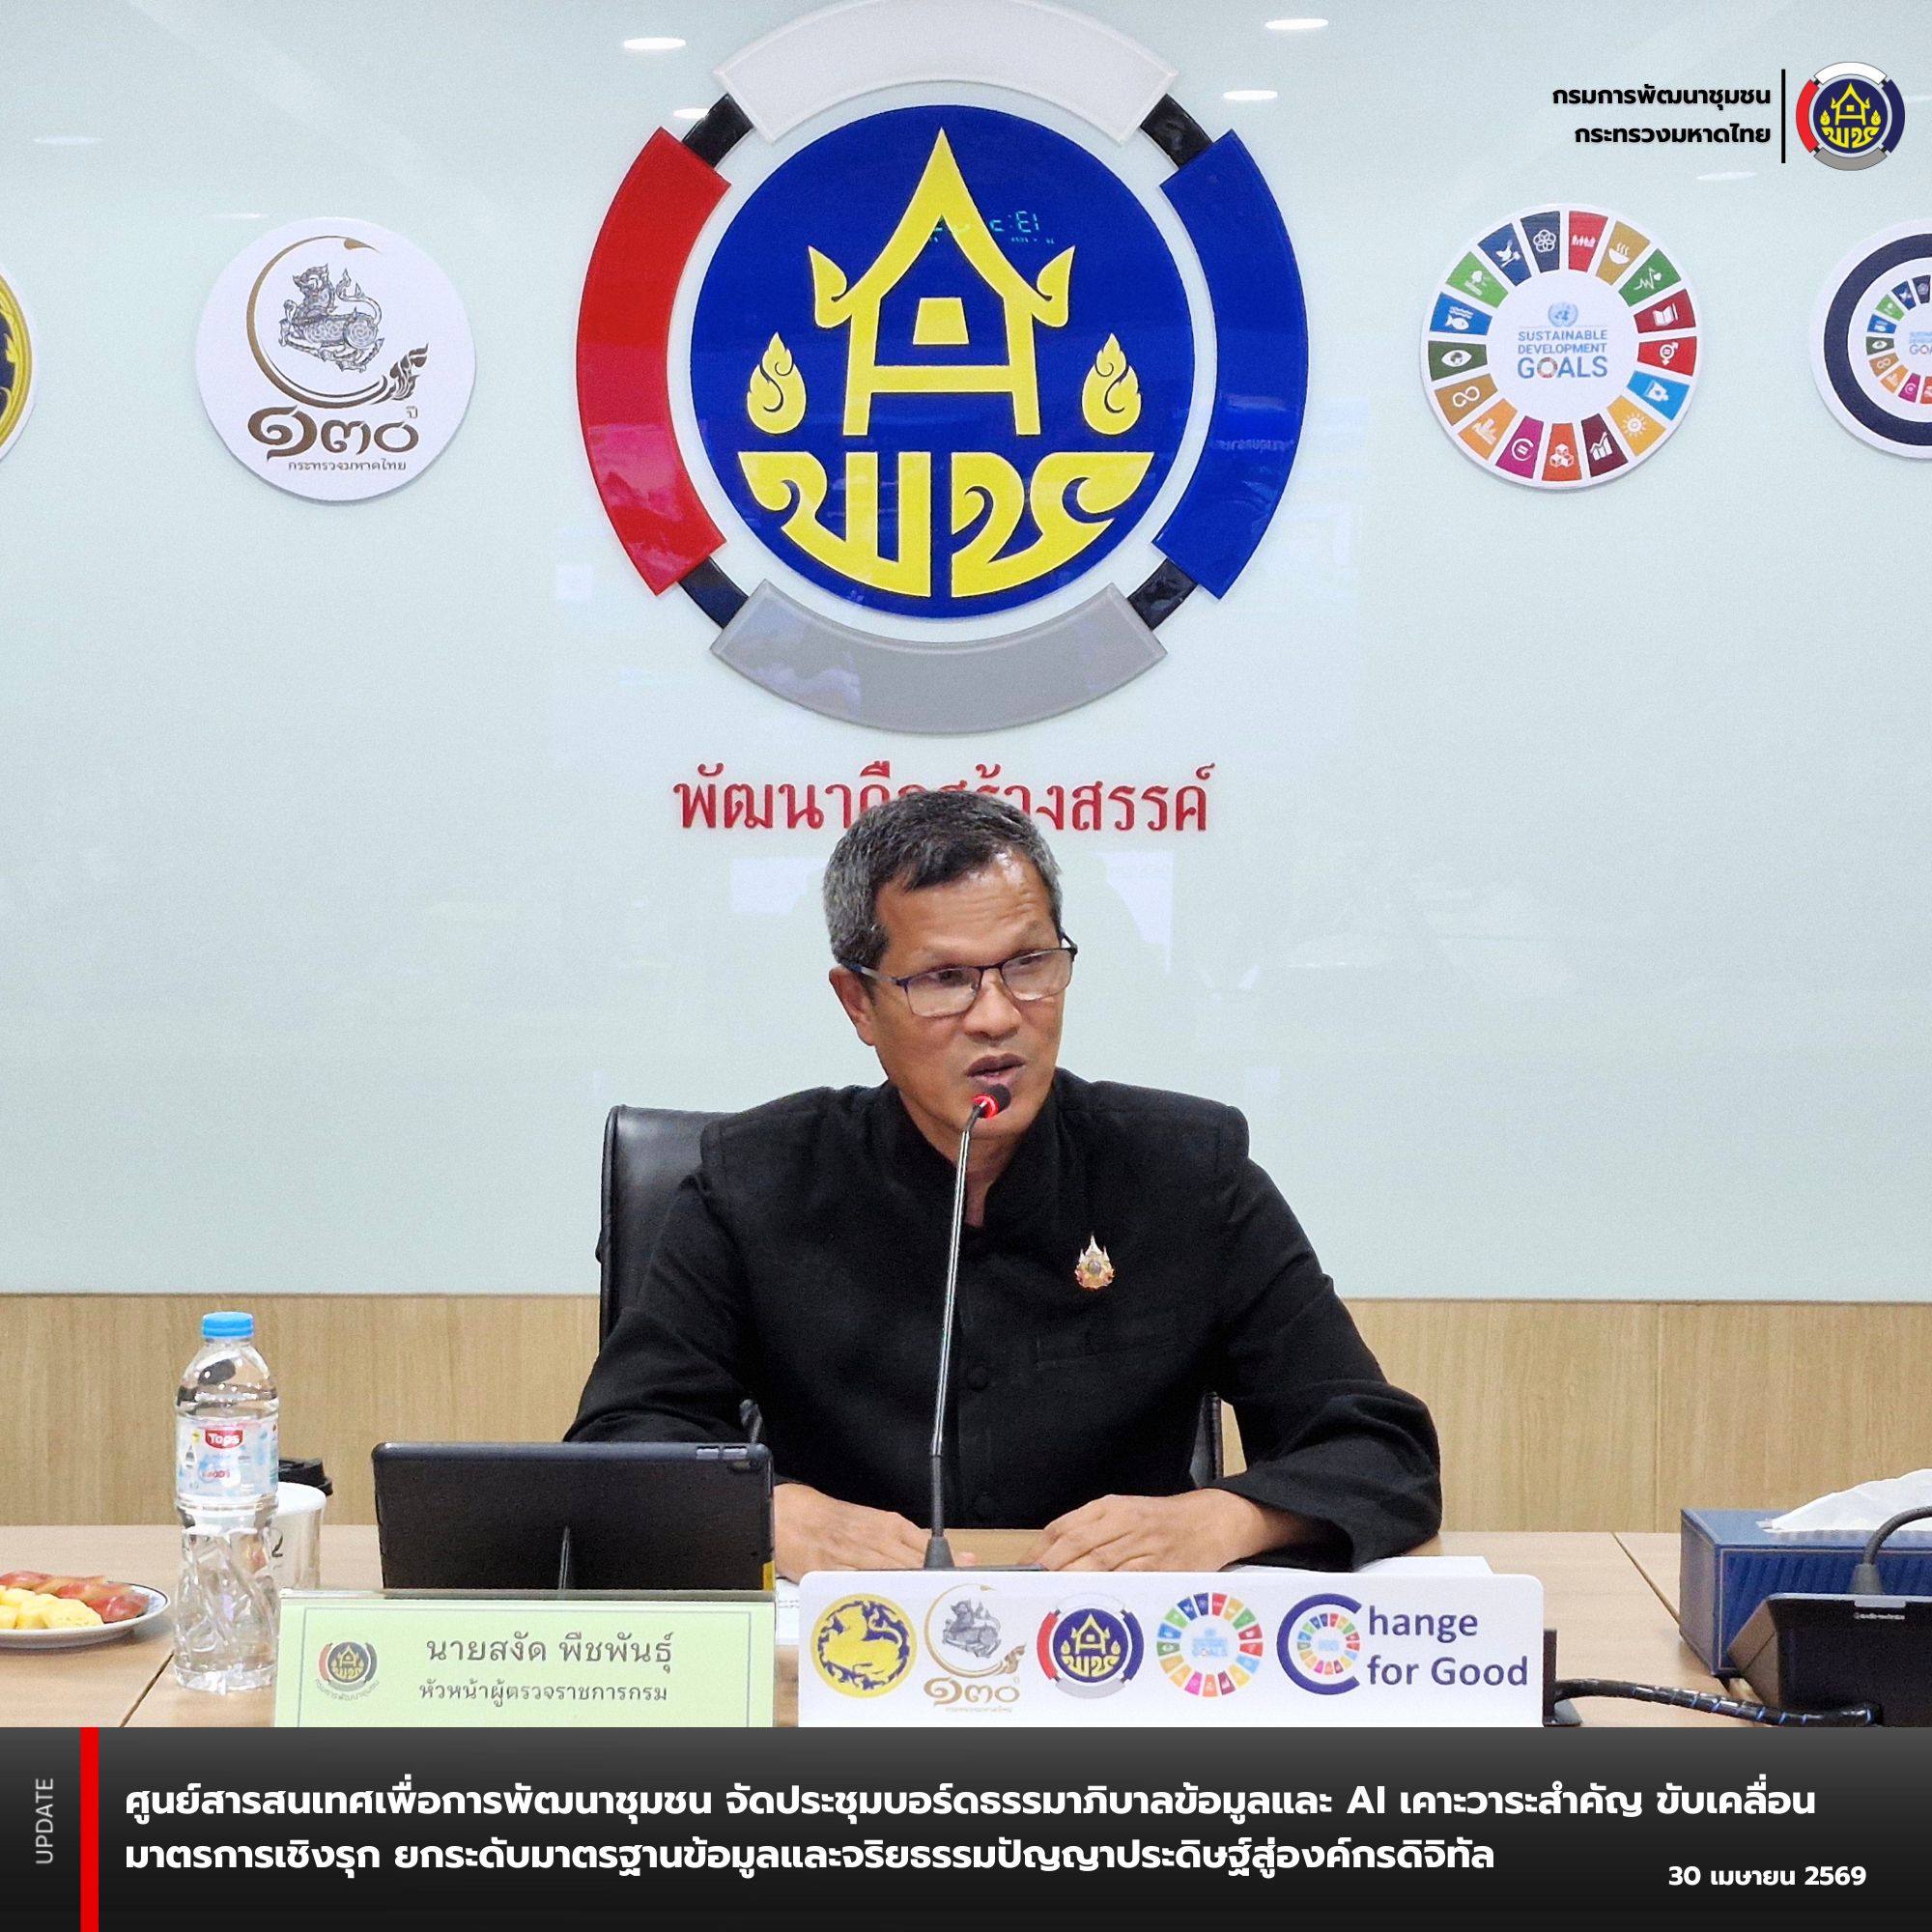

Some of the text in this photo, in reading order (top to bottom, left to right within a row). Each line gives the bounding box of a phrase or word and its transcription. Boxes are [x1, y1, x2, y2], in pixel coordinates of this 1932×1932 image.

[1518, 329, 1607, 342] SUSTAINABLE
[1518, 343, 1606, 355] DEVELOPMENT
[1518, 356, 1608, 379] GOALS
[288, 458, 407, 470] กระทรวงมหาดไทย
[207, 1433, 242, 1447] Tops
[426, 1631, 547, 1662] นายสงัด
[1367, 1655, 1528, 1686] for Good
[419, 1679, 668, 1708] หัวหน้าผู้ตรวจราชการกรม
